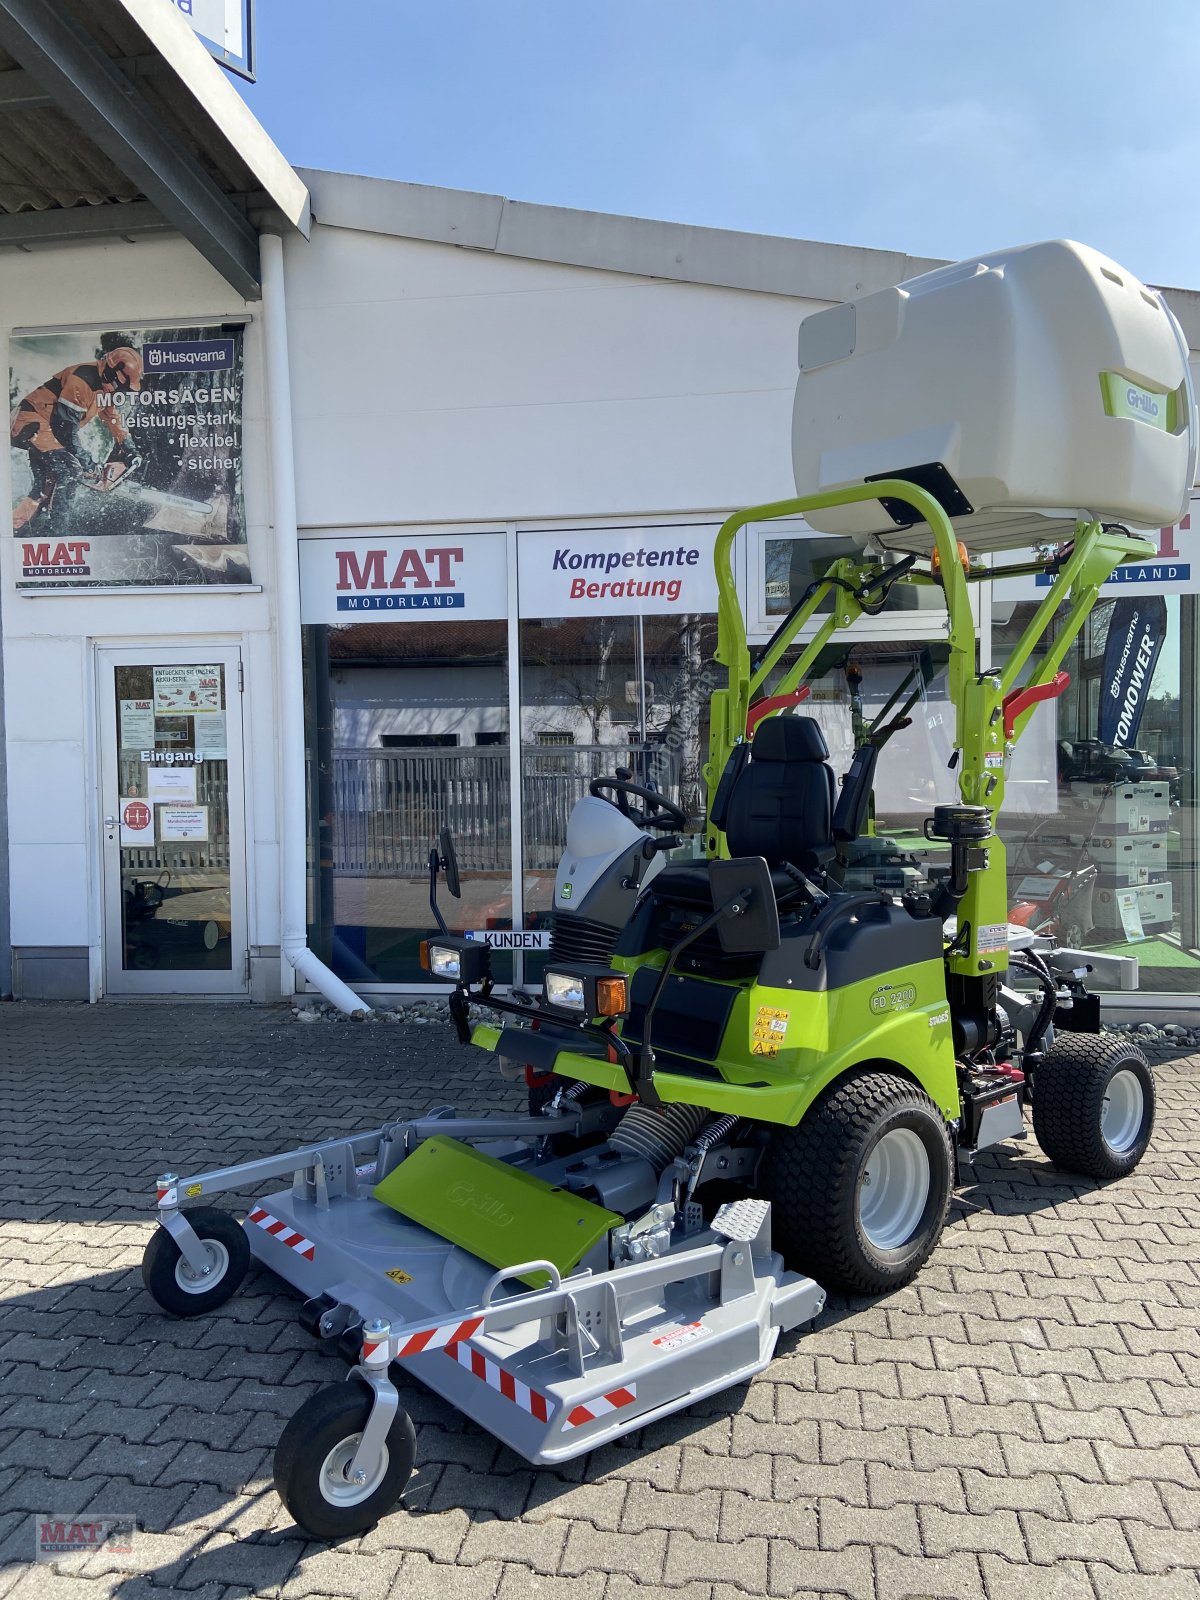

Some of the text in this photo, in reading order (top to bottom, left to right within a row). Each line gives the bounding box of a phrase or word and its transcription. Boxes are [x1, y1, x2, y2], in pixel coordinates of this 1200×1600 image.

[163, 349, 226, 366] Husqvarna
[97, 386, 236, 407] MOTORSÄGEN
[1126, 388, 1158, 417] Grillo
[122, 410, 237, 430] leistungsstark
[179, 432, 238, 448] flexibel
[188, 456, 238, 470] sicher
[22, 542, 90, 566] MAT
[552, 546, 700, 574] Kompetente
[28, 567, 84, 575] MOTORLAND
[335, 547, 464, 590] MAT
[1049, 567, 1177, 583] MRLAND
[569, 578, 682, 602] Beratung
[348, 595, 454, 608] MOTORLAND
[1114, 610, 1139, 685] Husqvarna
[140, 750, 204, 763] Eingang
[484, 933, 541, 948] KUNDEN
[873, 988, 914, 1009] FD 2200
